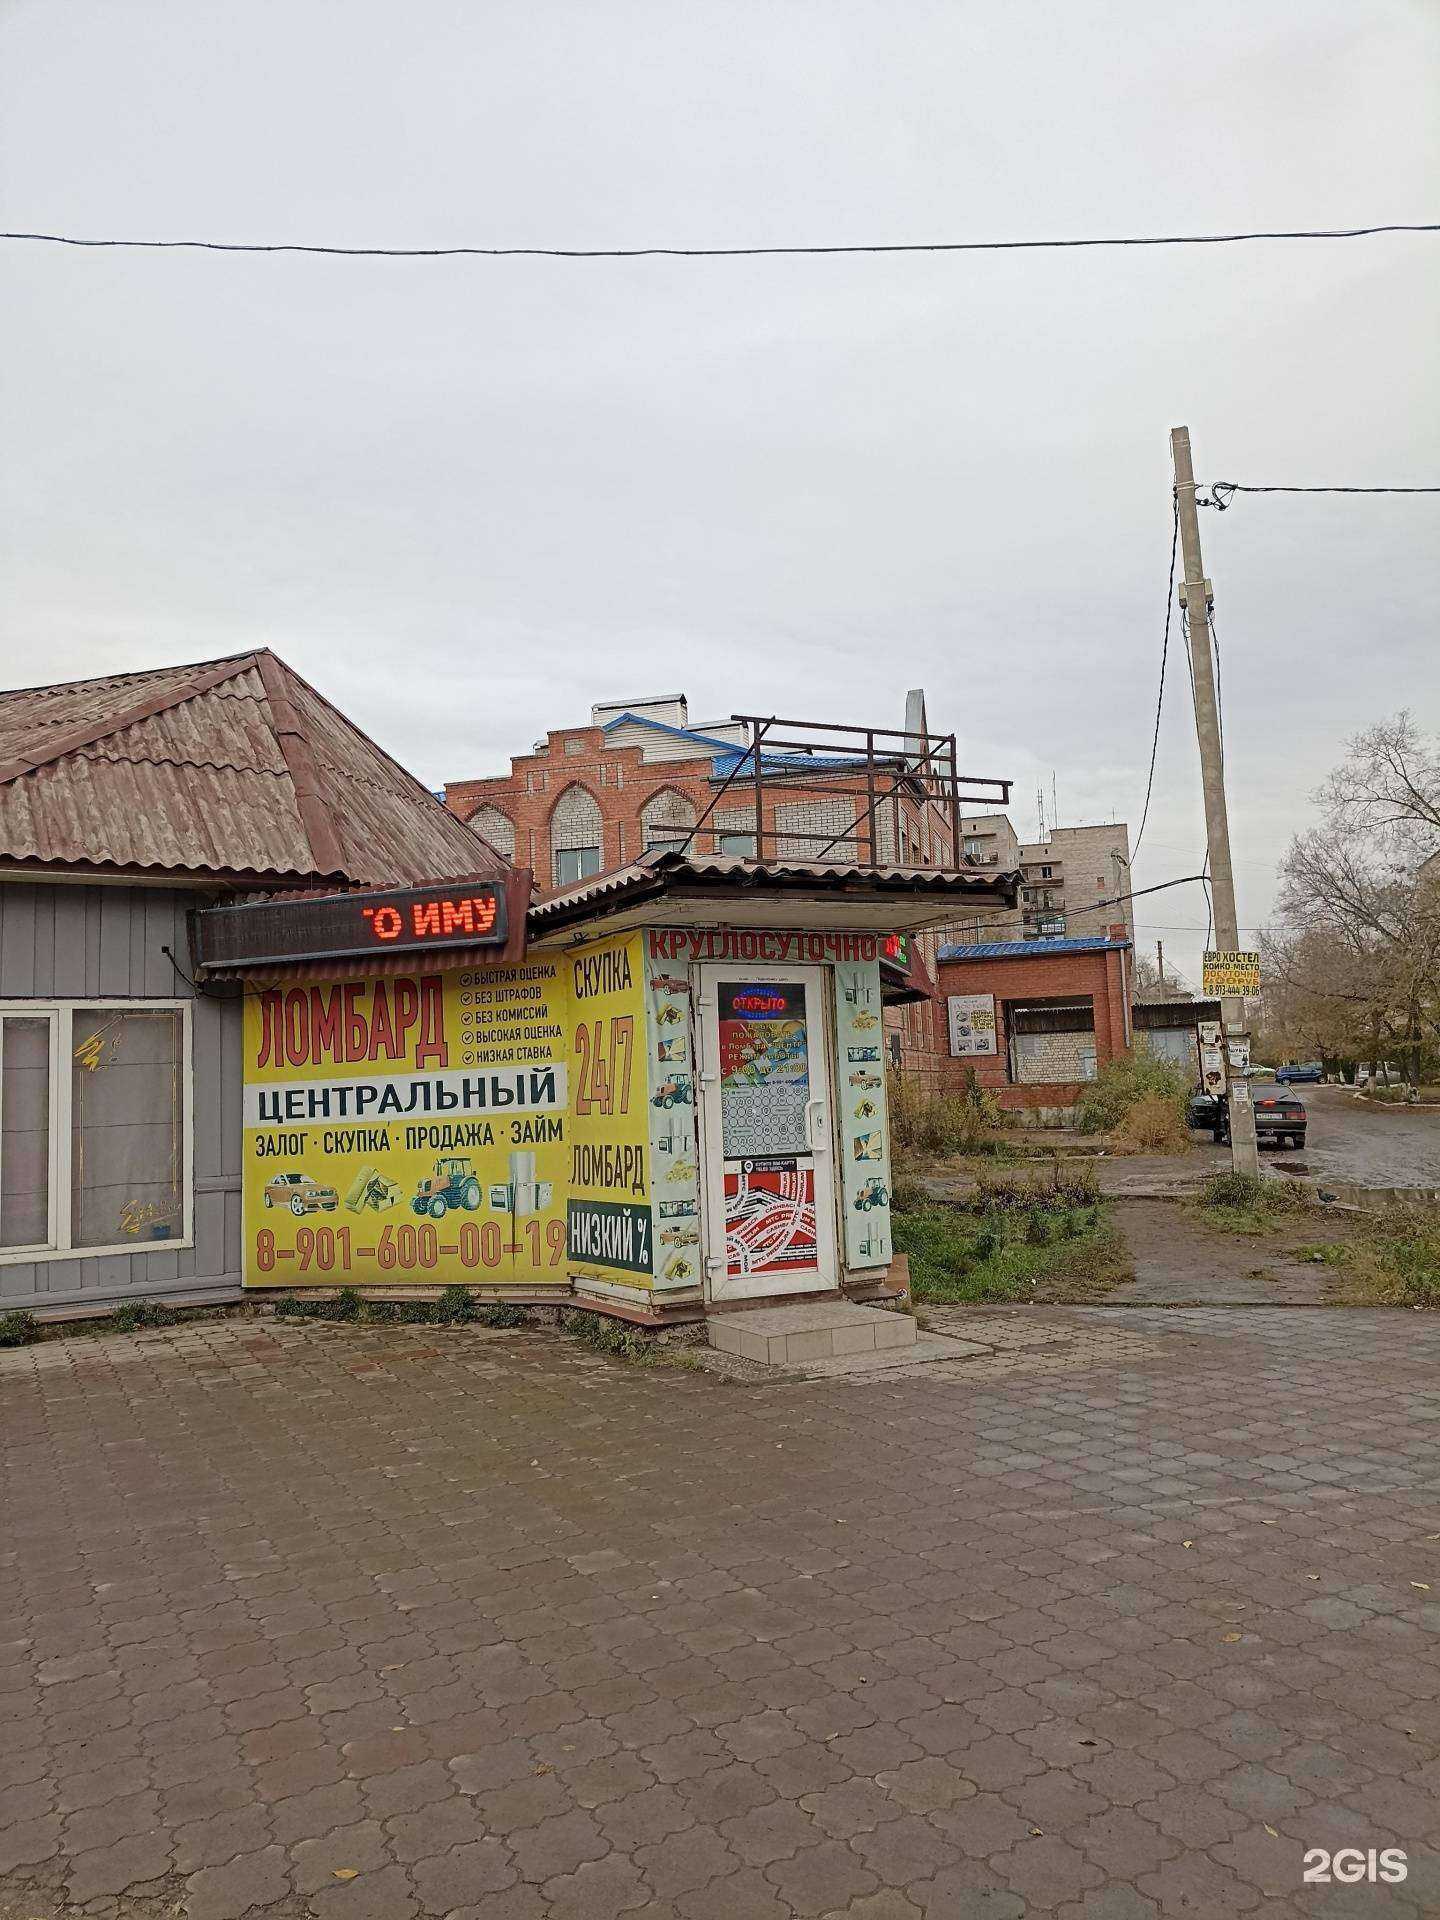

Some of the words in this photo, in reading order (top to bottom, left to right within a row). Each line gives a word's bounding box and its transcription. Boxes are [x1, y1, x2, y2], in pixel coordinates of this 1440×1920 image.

[412, 897, 496, 936] ИМУ
[650, 929, 879, 962] КРУГЛОСУТОЧНО
[1204, 952, 1221, 962] ЕВРО
[1222, 952, 1260, 963] ХОСТЕЛ
[474, 969, 517, 985] БЫСТРАЯ
[520, 965, 557, 981] ОЦЕНКА
[574, 947, 632, 999] СКУПКА
[1203, 962, 1260, 970] КОЙКО-МЕСТО
[1203, 970, 1260, 978] ПОСУТОЧНО
[475, 991, 492, 1004] БЕЗ
[495, 987, 542, 1002] ШТРАФОВ
[733, 997, 785, 1010] ОТКРЫТО
[257, 975, 448, 1069] ЛОМБАРД
[475, 1011, 493, 1024] БЕЗ
[496, 1004, 548, 1022] КОМИССИЙ
[476, 1028, 521, 1044] ВЫСОКАЯ
[524, 1025, 562, 1040] ОЦЕНКА
[477, 1048, 514, 1063] НИЗКАЯ
[516, 1045, 552, 1060] СТАВКА
[575, 1015, 634, 1115] 24/7
[258, 1067, 556, 1123] ЦЕНТРАЛЬНЫЙ
[256, 1133, 308, 1157] ЗАЛОГ
[323, 1129, 390, 1155] СКУПКА
[406, 1123, 495, 1151] ПРОДАЖА
[511, 1115, 563, 1145] ЗАЙМ
[571, 1144, 645, 1196] ЛОМБАРД
[256, 1219, 567, 1272] 8-901-600-00-19
[571, 1208, 633, 1261] НИЗКИЙ
[637, 1218, 649, 1265] %
